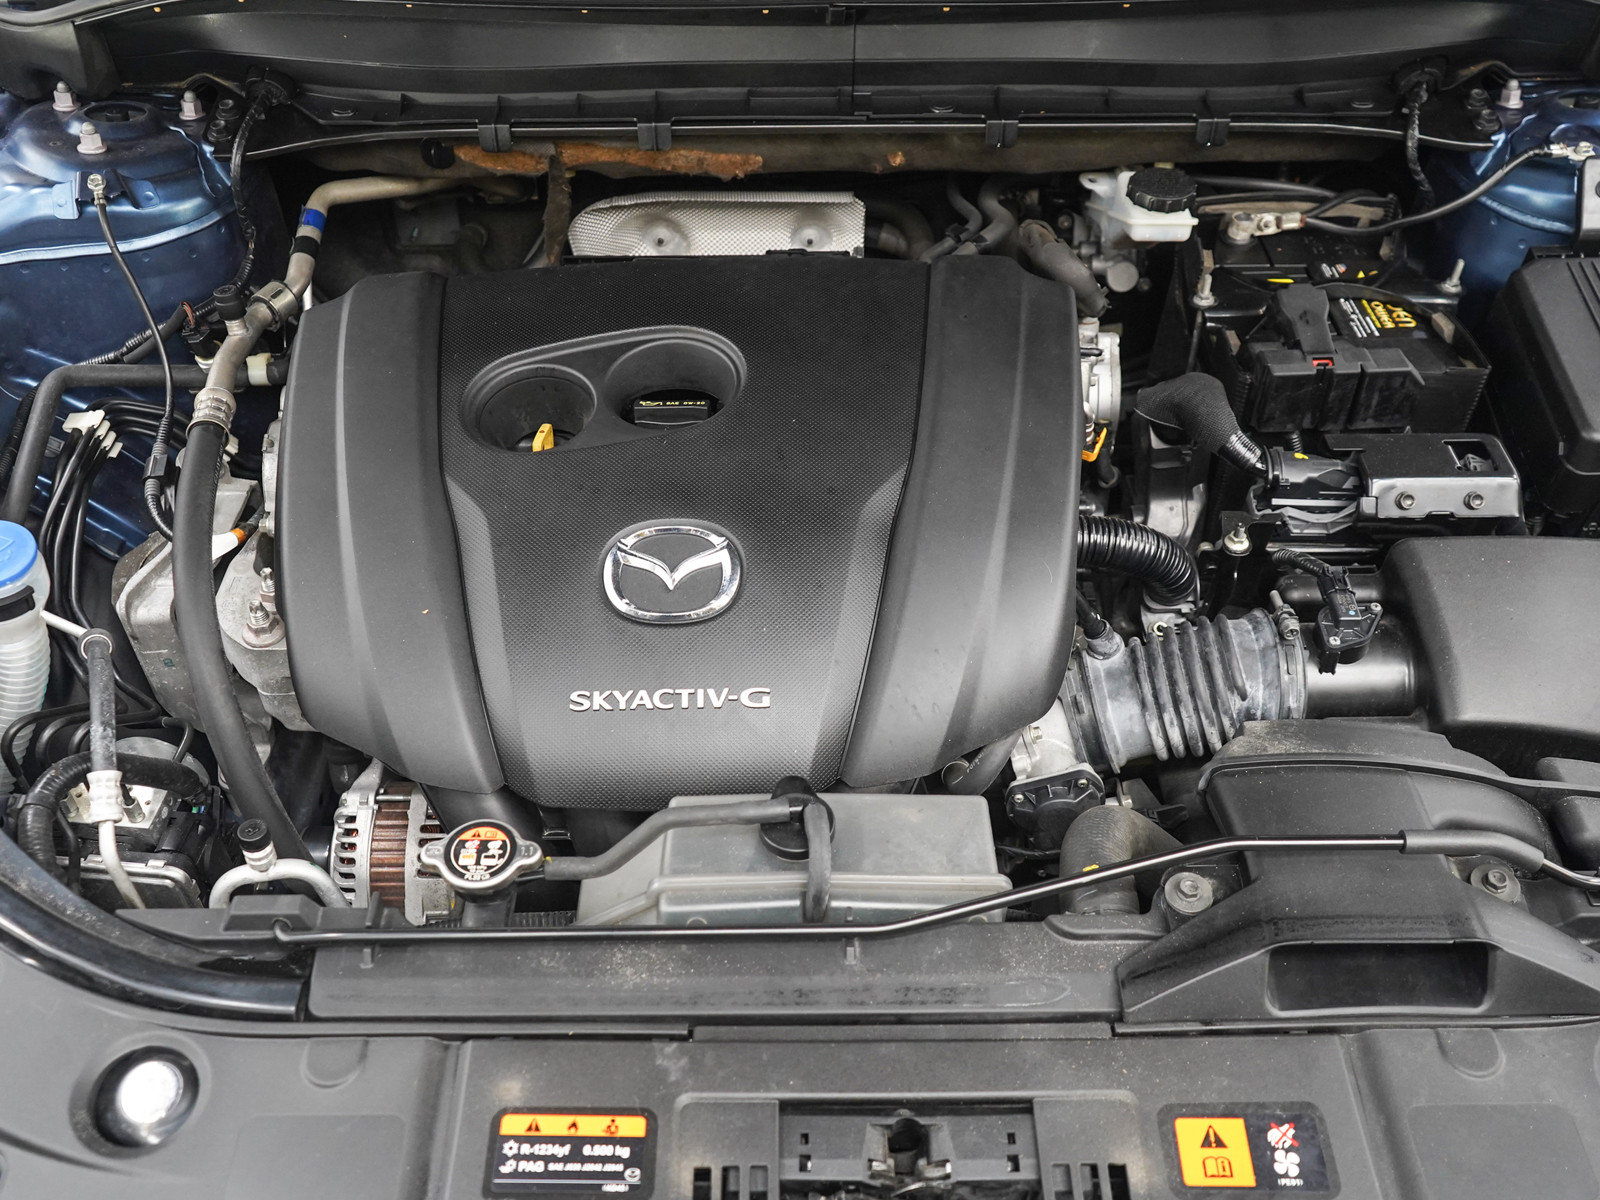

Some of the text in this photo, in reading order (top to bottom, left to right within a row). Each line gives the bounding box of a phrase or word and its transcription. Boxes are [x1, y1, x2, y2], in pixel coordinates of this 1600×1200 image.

[569, 687, 771, 712] SKYACTIV-G
[519, 1143, 571, 1158] R-1234yf
[615, 1145, 631, 1159] kg
[518, 1160, 545, 1173] PAG
